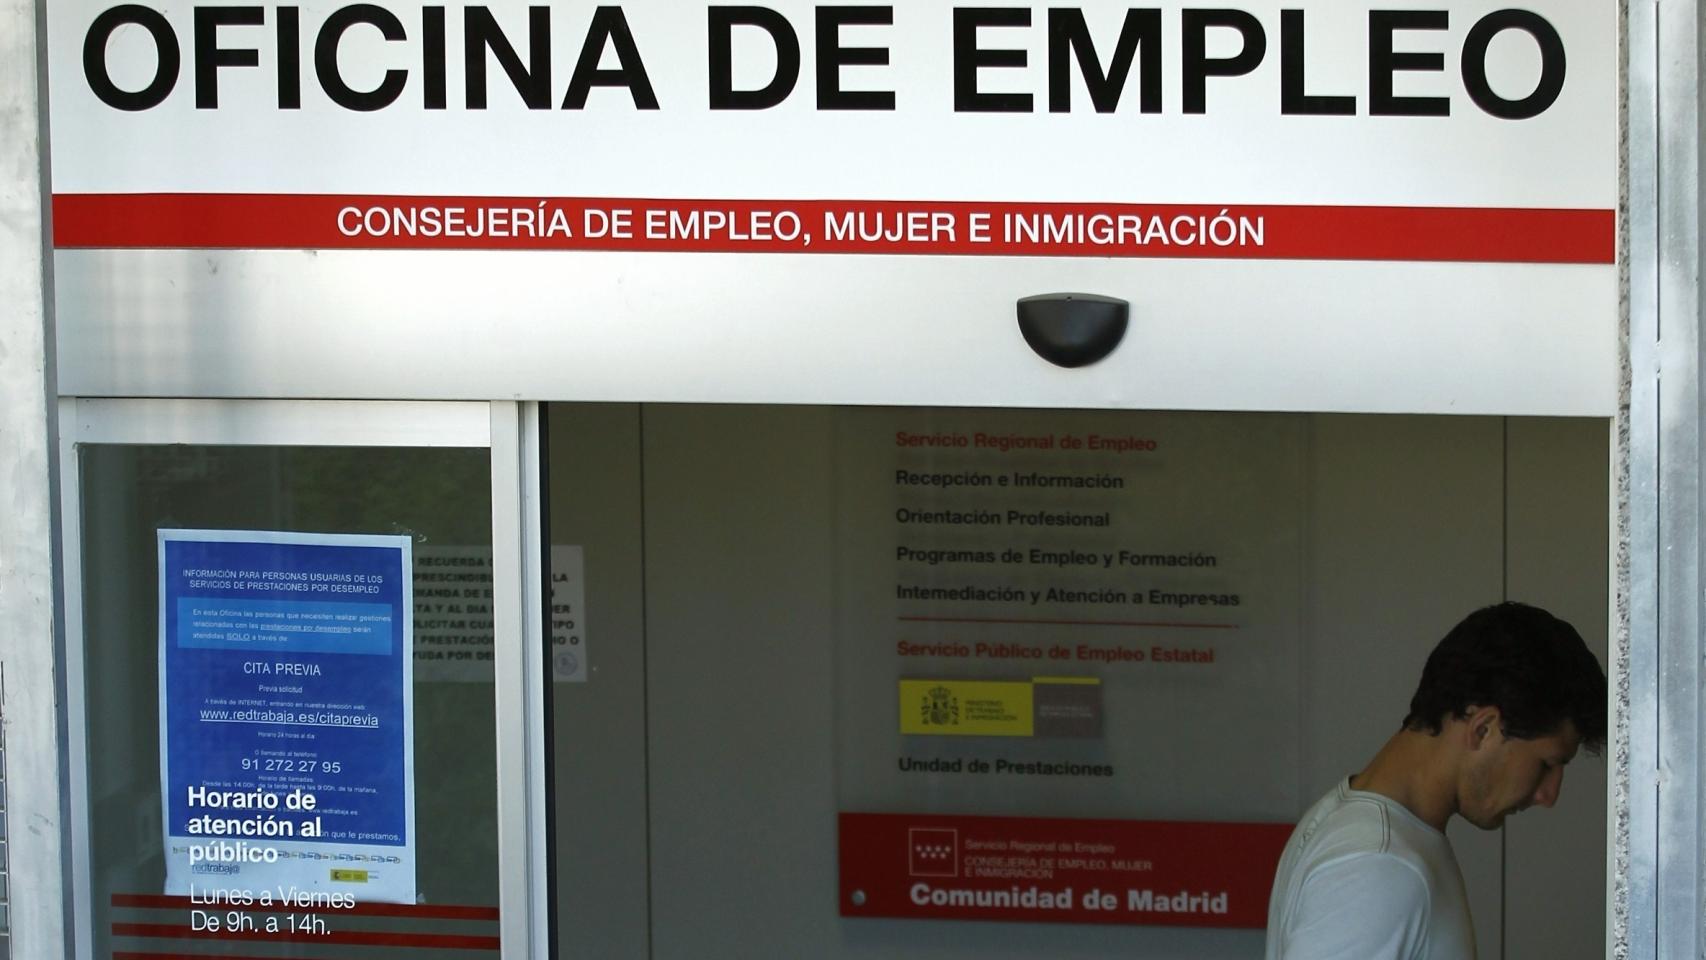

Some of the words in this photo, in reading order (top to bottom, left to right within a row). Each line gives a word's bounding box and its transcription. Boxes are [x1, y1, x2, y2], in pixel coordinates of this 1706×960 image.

[82, 3, 660, 111] OFICINA
[708, 5, 896, 111] DE
[952, 8, 1567, 120] EMPLEO
[337, 200, 567, 239] CONSEJERÍA
[584, 210, 633, 240] DE
[645, 211, 811, 246] EMPLEO,
[824, 212, 957, 243] MUJER
[969, 213, 991, 242] E
[1003, 208, 1265, 247] INMIGRACIÓN
[896, 432, 968, 448] Servicio
[974, 433, 1053, 452] Regional
[1060, 435, 1082, 449] de
[1088, 435, 1157, 453] Empleo
[896, 470, 993, 489] Recepción
[998, 475, 1009, 487] e
[1014, 472, 1124, 489] Información
[896, 509, 1001, 526] Orientación
[1007, 510, 1110, 527] Profesional
[418, 557, 485, 567] RECUERDA
[896, 547, 995, 566] Programas
[1001, 548, 1023, 563] de
[1029, 549, 1097, 567] Empleo
[1103, 554, 1113, 568] y
[1119, 550, 1217, 568] Formación
[182, 569, 237, 579] INFORMACIÓN
[239, 570, 260, 579] PARA
[262, 571, 308, 581] PERSONAS
[310, 573, 351, 582] USUARIAS
[354, 574, 366, 583] DE
[367, 575, 383, 583] LOS
[552, 573, 568, 583] LA
[189, 580, 231, 590] SERVICIOS
[234, 581, 246, 590] DE
[247, 582, 309, 592] PRESTACIONES
[311, 583, 329, 593] POR
[331, 584, 380, 594] DESEMPLEO
[415, 589, 460, 598] MANDA
[463, 589, 481, 598] DE
[1029, 591, 1040, 606] y
[1045, 587, 1126, 604] Atención
[1132, 592, 1143, 604] a
[1149, 590, 1240, 607] Empresas
[435, 604, 443, 613] Y
[447, 604, 462, 613] AL
[415, 620, 465, 629] LICITAR
[447, 651, 472, 660] POR
[897, 641, 969, 658] Servicio
[975, 642, 1042, 659] Público
[1048, 644, 1070, 660] de
[1076, 645, 1144, 663] Empleo
[1151, 646, 1215, 663] Estatal
[243, 661, 271, 675] CITA
[275, 662, 321, 677] PREVIA
[258, 684, 277, 693] Previa
[200, 708, 379, 728] www.redtrabaja.es/citaprevia
[242, 758, 259, 770] 91
[265, 759, 293, 772] 272
[298, 760, 317, 772] 27
[322, 761, 341, 774] 95
[898, 757, 962, 774] Unidad
[967, 758, 990, 774] de
[996, 759, 1114, 777] Prestaciones
[188, 786, 278, 809] Horario
[285, 788, 316, 810] de
[188, 815, 293, 837] atención
[301, 816, 321, 837] al
[331, 831, 346, 839] que
[348, 830, 356, 838] le
[189, 841, 278, 866] público
[964, 839, 1007, 851] Servicio
[1009, 841, 1056, 854] Regional
[1059, 842, 1072, 853] de
[1075, 843, 1115, 856] Empleo
[964, 855, 1037, 868] CONSEJERÍA
[1040, 858, 1056, 869] DE
[1112, 860, 1153, 872] MUJER
[965, 867, 973, 878] E
[190, 883, 253, 906] Lunes
[259, 892, 272, 907] a
[278, 886, 355, 909] Viernes
[910, 883, 1072, 910] Comunidad
[1083, 889, 1118, 911] de
[1128, 890, 1228, 914] Madrid
[191, 910, 220, 932] De
[226, 911, 259, 933] 9h.
[265, 919, 278, 933] a
[286, 913, 331, 935] 14h.
